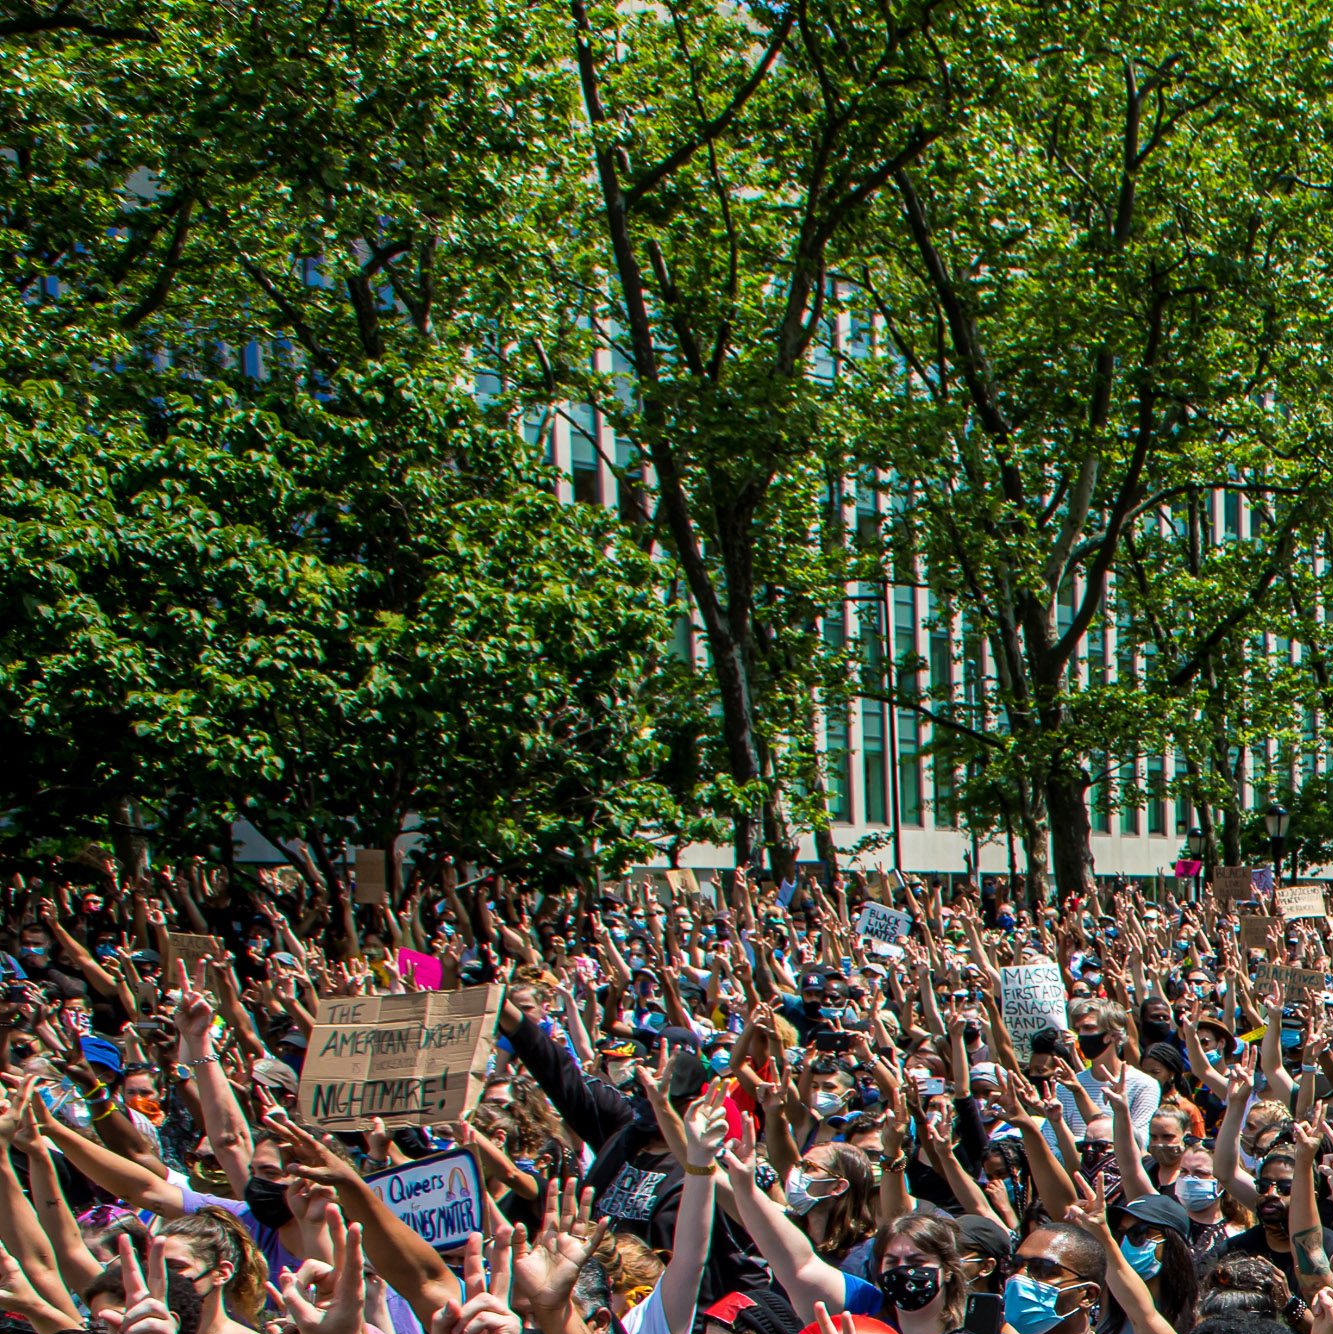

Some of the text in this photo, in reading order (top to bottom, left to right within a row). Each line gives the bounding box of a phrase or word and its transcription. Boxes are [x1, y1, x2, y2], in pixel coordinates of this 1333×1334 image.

[869, 908, 901, 927] BLACK
[863, 925, 897, 944] MATTE
[867, 918, 898, 936] LIVES
[1003, 968, 1059, 985] MASKS
[1256, 965, 1291, 981] BLACK
[1004, 985, 1062, 1000] FIRST AID
[327, 1003, 366, 1024] THE
[1005, 999, 1065, 1015] SNACKS
[1004, 1016, 1047, 1029] HAND
[319, 1021, 472, 1057] AMERICAN DREAM
[311, 1066, 449, 1117] NIGHTMARE!
[387, 1174, 445, 1205] Queers
